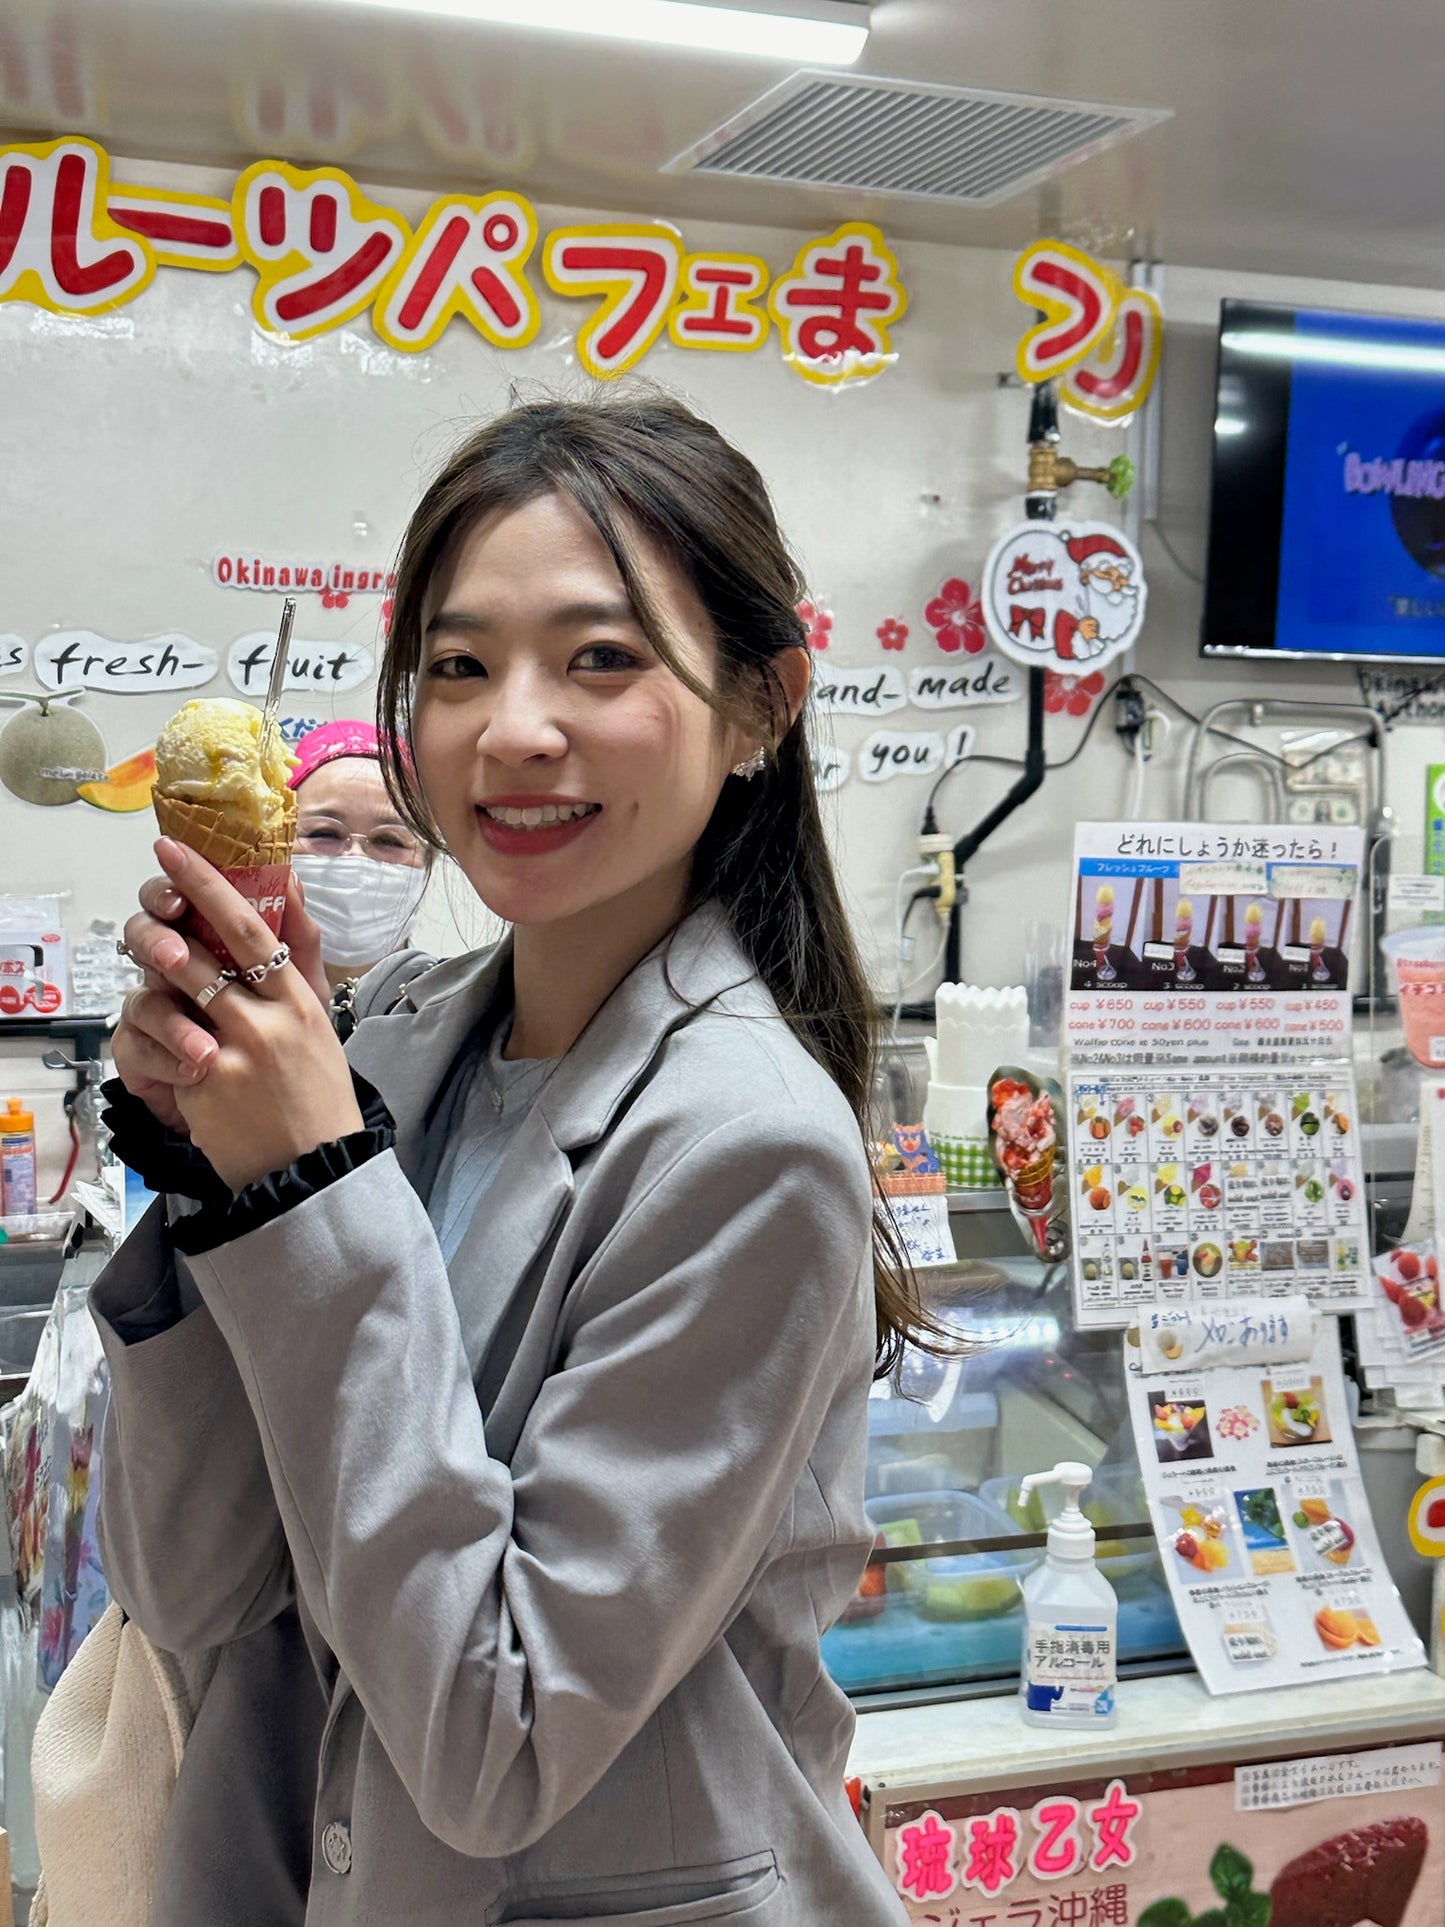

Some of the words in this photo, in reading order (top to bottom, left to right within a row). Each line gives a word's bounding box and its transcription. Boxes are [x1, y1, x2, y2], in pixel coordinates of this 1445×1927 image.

[217, 556, 323, 587] Okinawa
[238, 644, 360, 686] fuit
[918, 661, 1010, 698] made
[1034, 1655, 1106, 1669] アルコール
[1035, 1639, 1111, 1655] 手指消毒用
[902, 1786, 1139, 1898] 琉球乙女
